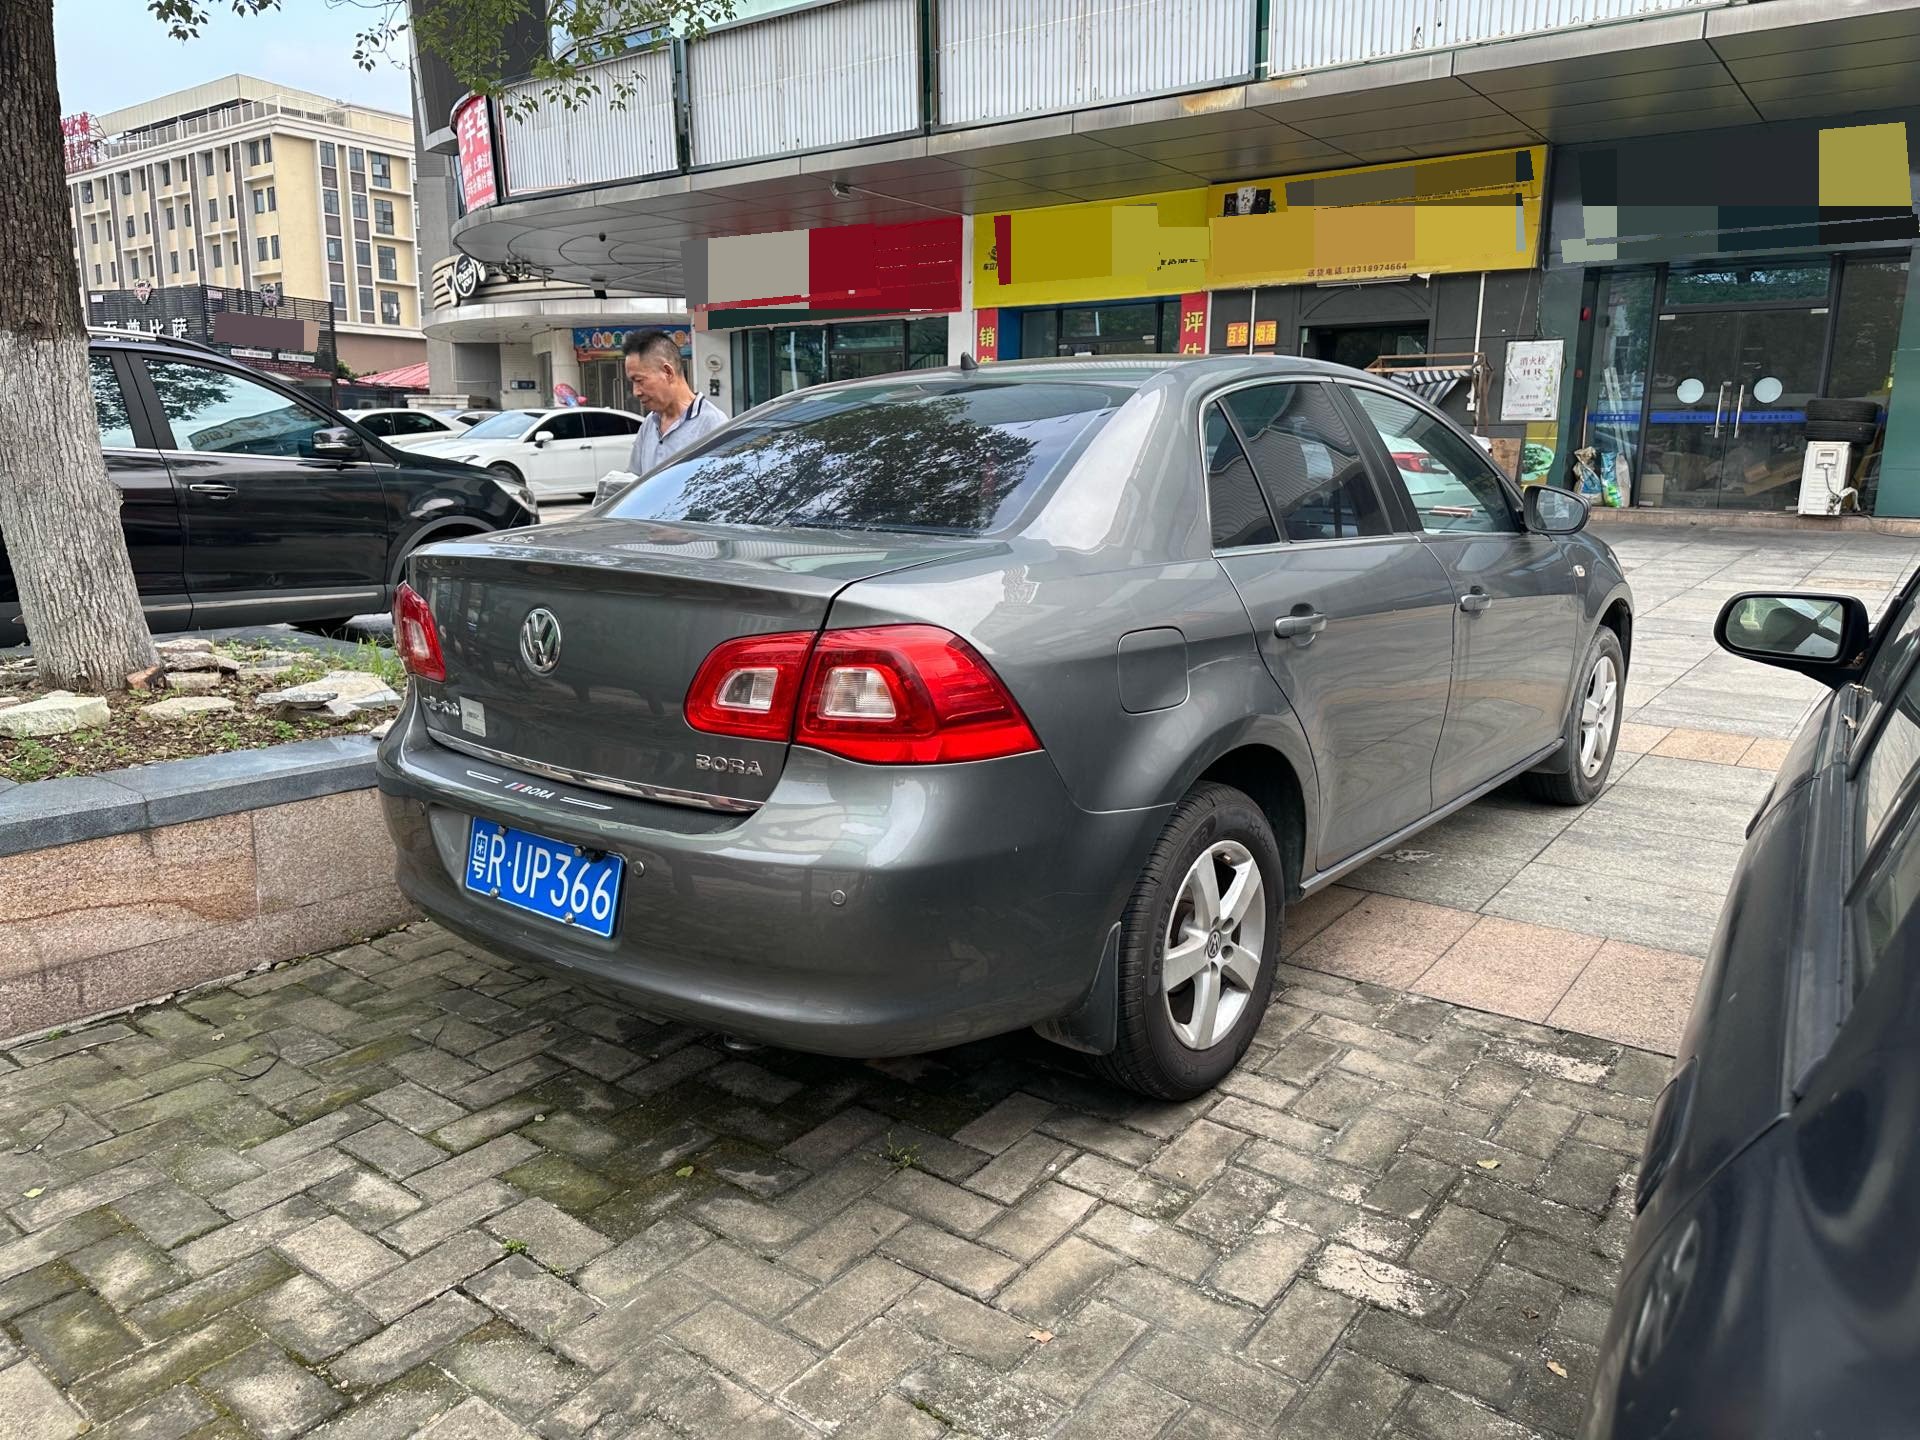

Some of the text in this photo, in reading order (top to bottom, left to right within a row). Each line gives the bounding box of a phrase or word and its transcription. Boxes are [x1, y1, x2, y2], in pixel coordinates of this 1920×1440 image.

[1228, 324, 1276, 344] 百货 烟酒
[695, 753, 763, 776] BORA
[519, 785, 556, 799] BORA
[472, 829, 613, 921] 粤R·UP366
